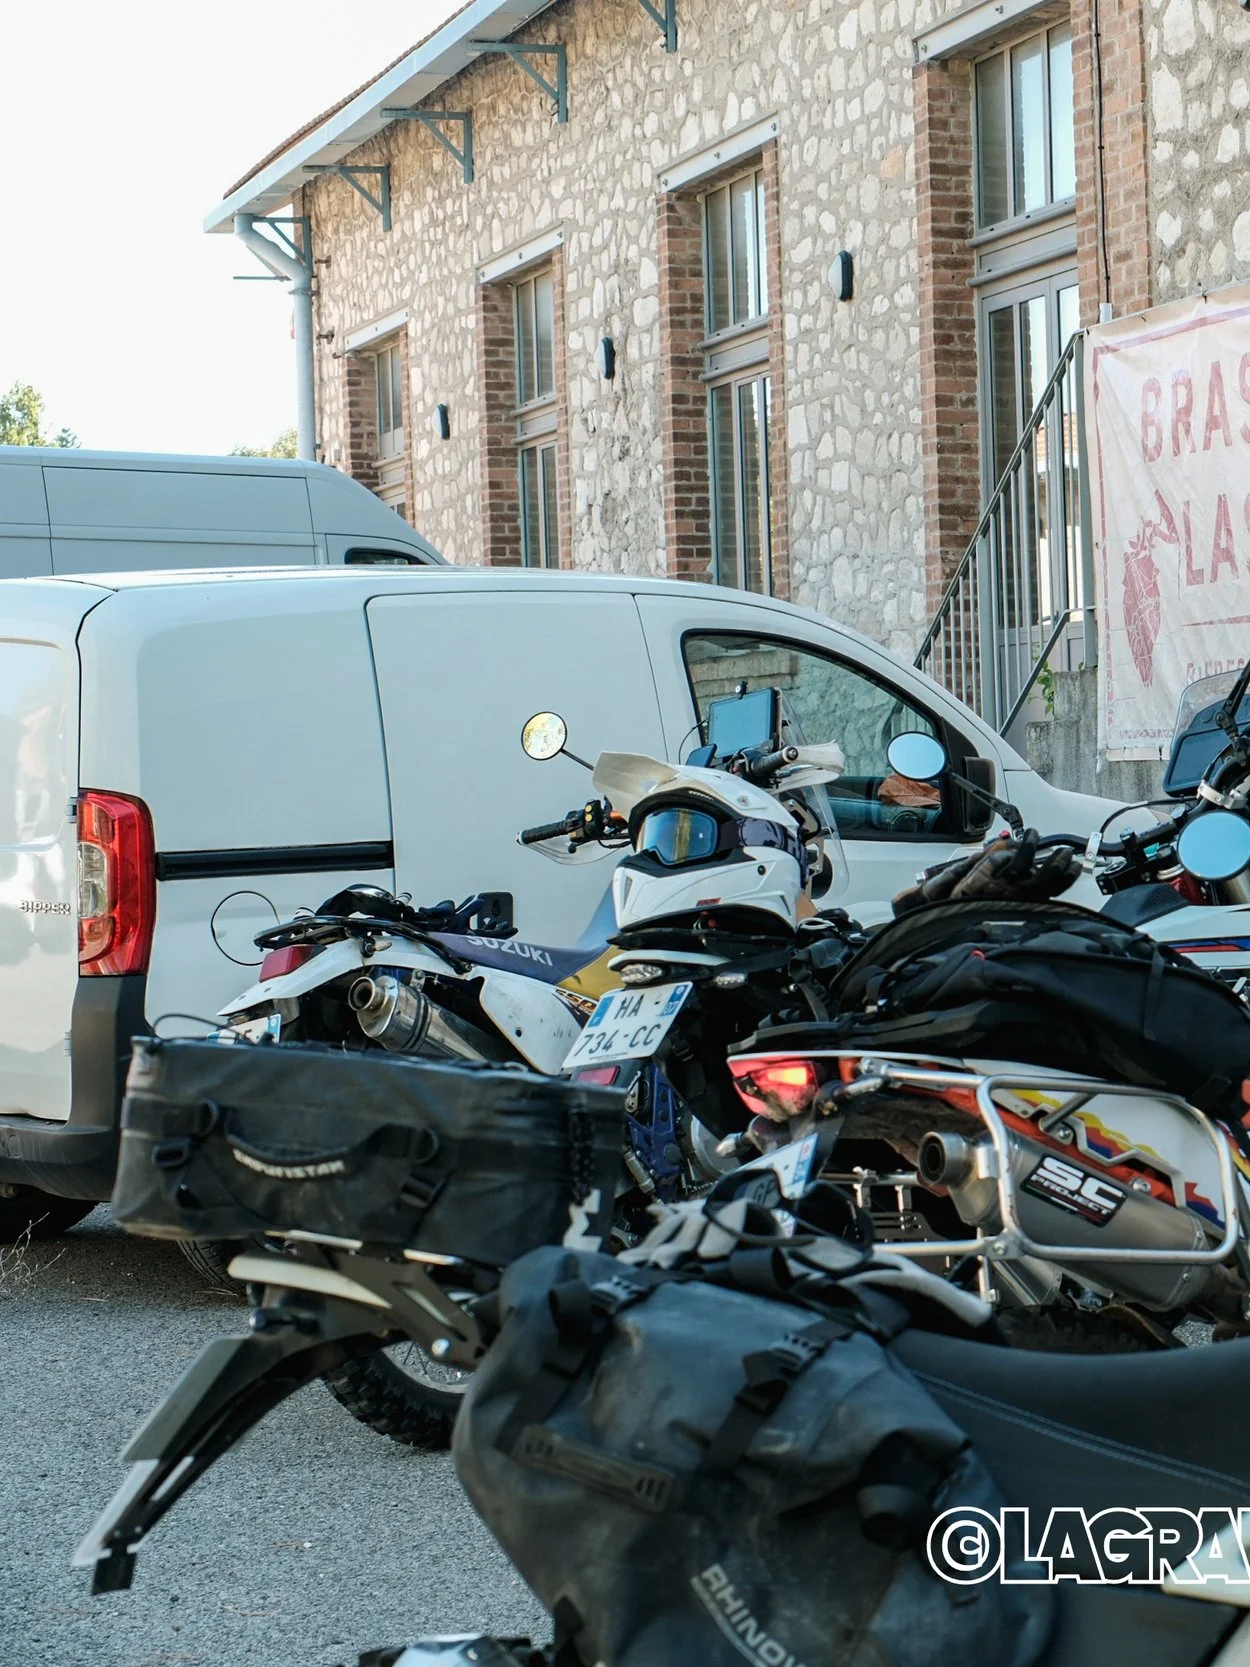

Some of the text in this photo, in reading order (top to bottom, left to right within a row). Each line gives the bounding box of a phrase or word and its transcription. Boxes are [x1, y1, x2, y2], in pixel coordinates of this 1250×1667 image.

[20, 900, 71, 915] BIPPER
[1030, 1174, 1112, 1215] PROJECT
[1036, 1156, 1125, 1210] SC
